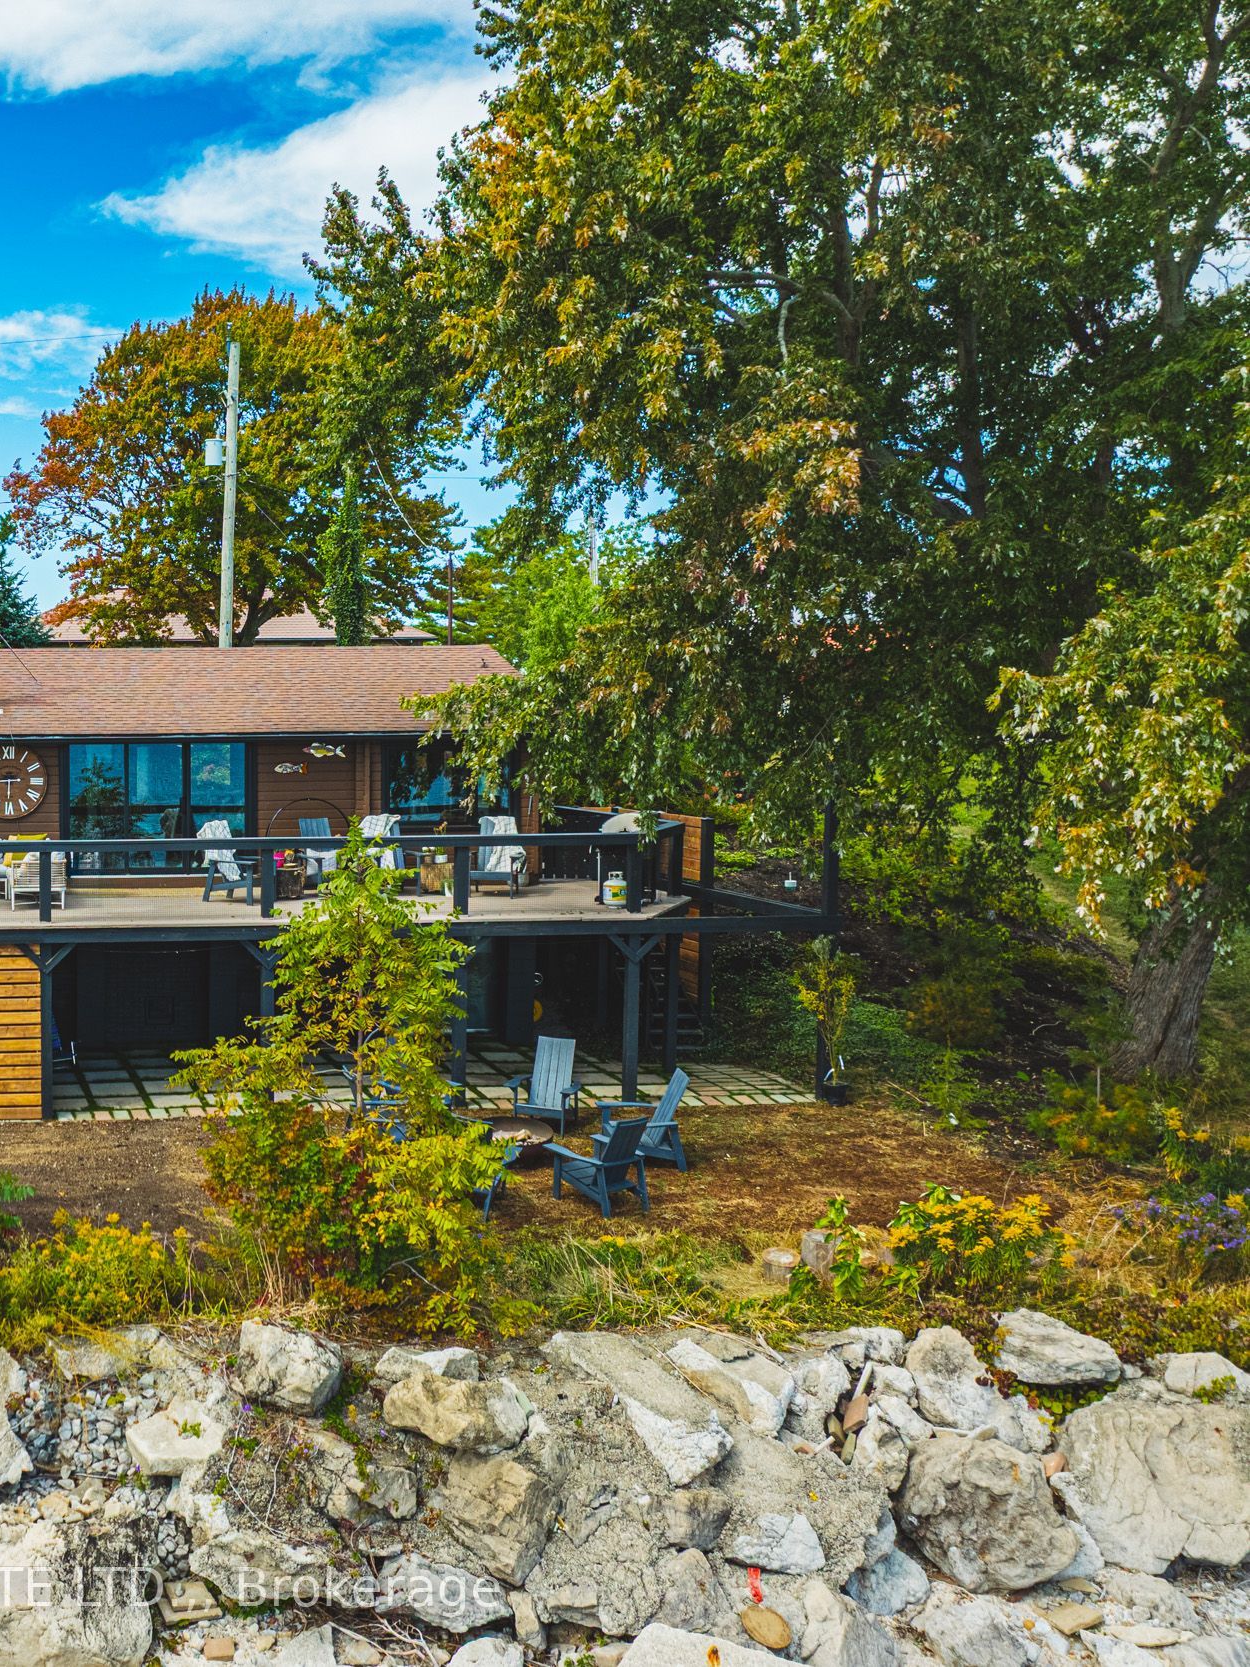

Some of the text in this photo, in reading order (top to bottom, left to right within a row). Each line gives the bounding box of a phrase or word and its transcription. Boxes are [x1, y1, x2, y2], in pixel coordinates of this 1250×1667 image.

[2, 746, 15, 760] XII
[20, 751, 28, 763] I
[27, 762, 40, 773] II
[30, 777, 44, 785] III
[4, 801, 14, 815] VI
[18, 799, 29, 812] V
